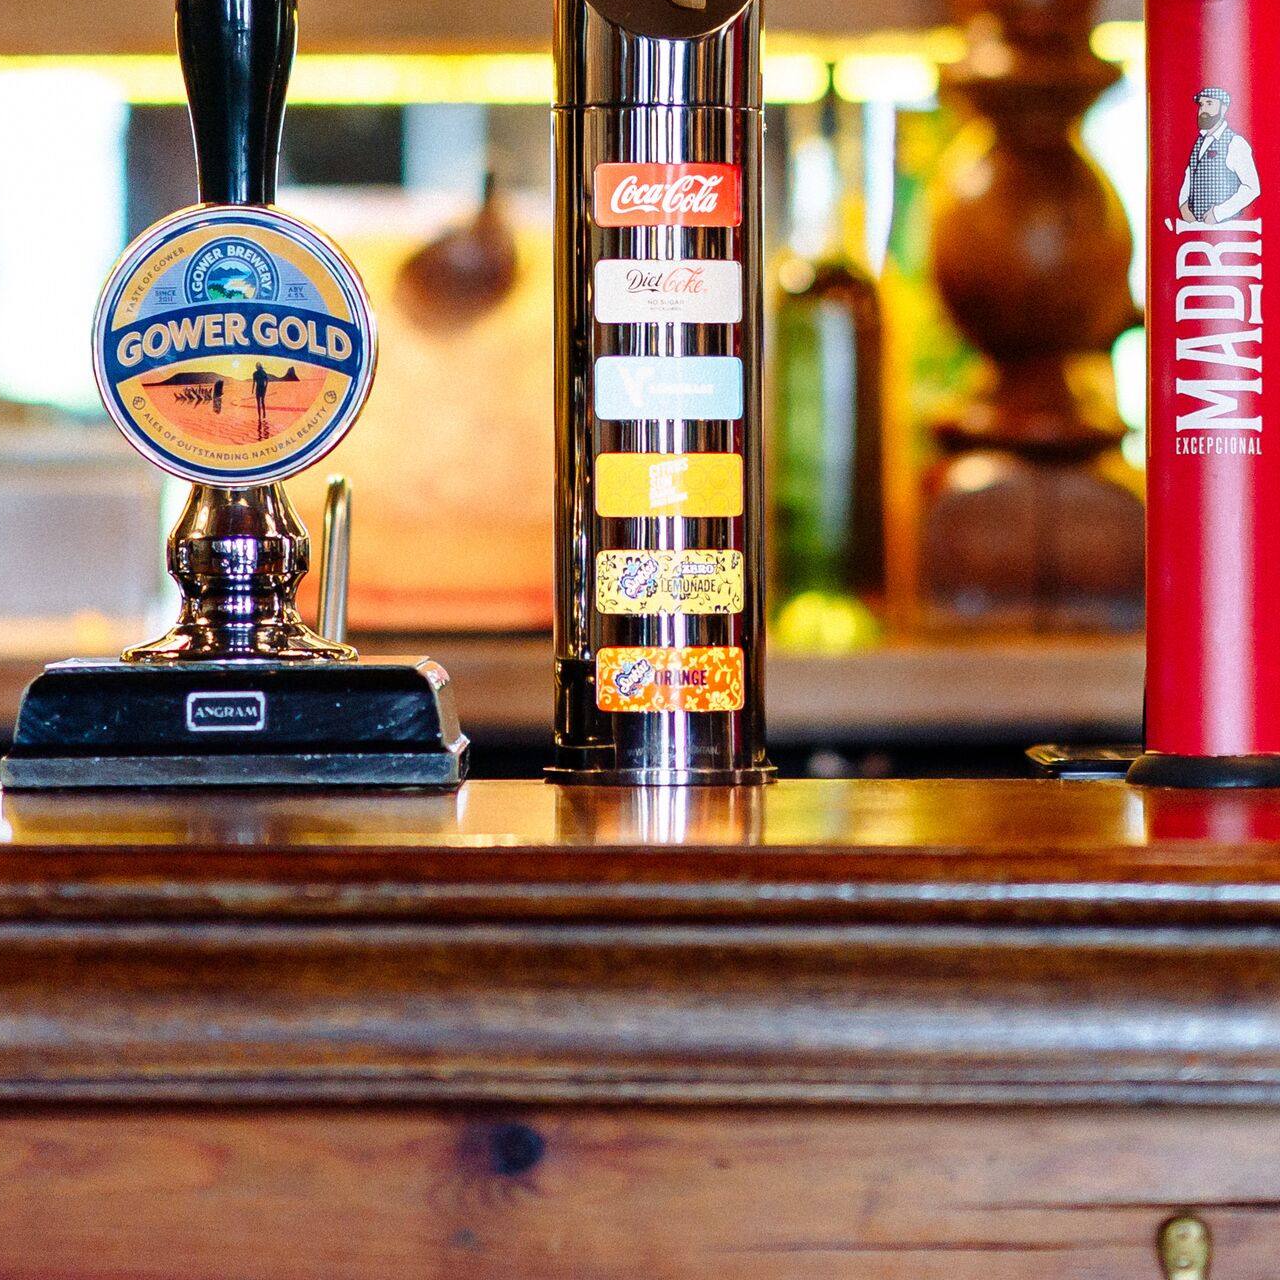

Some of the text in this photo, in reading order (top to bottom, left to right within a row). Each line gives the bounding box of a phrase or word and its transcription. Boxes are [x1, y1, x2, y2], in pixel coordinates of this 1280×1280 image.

[126, 246, 185, 312] TASTE OF GOWER
[191, 245, 274, 293] GOWER BREWERY
[626, 267, 706, 294] Diet Coke
[1165, 217, 1263, 432] MADRÍ
[117, 313, 353, 367] GOWER GOLD
[143, 405, 328, 461] ALES OF OUTSTANDING NATURAL BEAUTY
[1175, 436, 1263, 455] EXCEPCIONAL
[681, 563, 715, 574] ZERO
[661, 580, 716, 592] LEMONADE
[654, 669, 708, 686] ORANGE
[194, 706, 258, 718] ANGRAM
